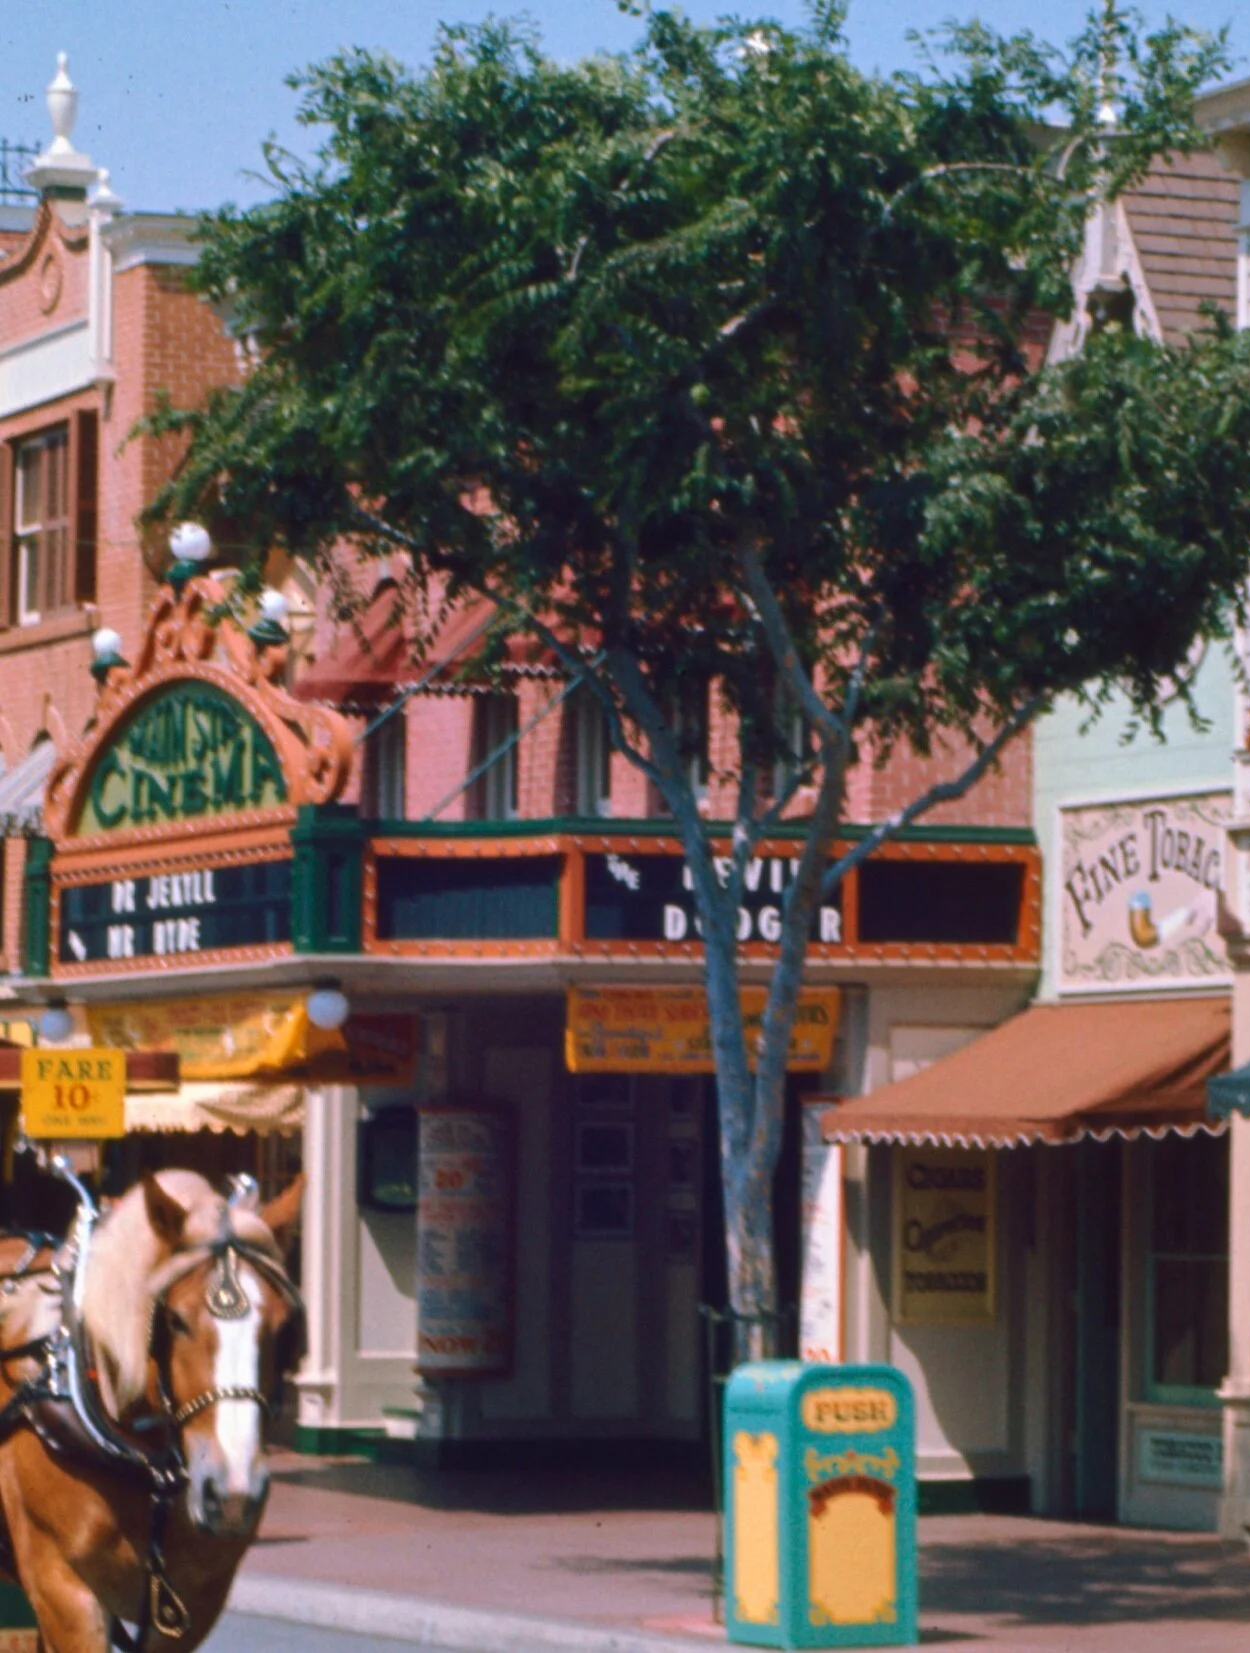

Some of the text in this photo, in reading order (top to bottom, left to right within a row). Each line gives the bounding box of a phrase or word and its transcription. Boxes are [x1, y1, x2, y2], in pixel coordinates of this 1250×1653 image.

[91, 736, 289, 830] CINEMA
[146, 869, 217, 911] JEKYLL
[682, 856, 805, 894] EVI
[1064, 833, 1141, 939] FINE
[663, 904, 842, 944] DDGR
[36, 1058, 113, 1081] FARE
[813, 1400, 889, 1424] PUSH
